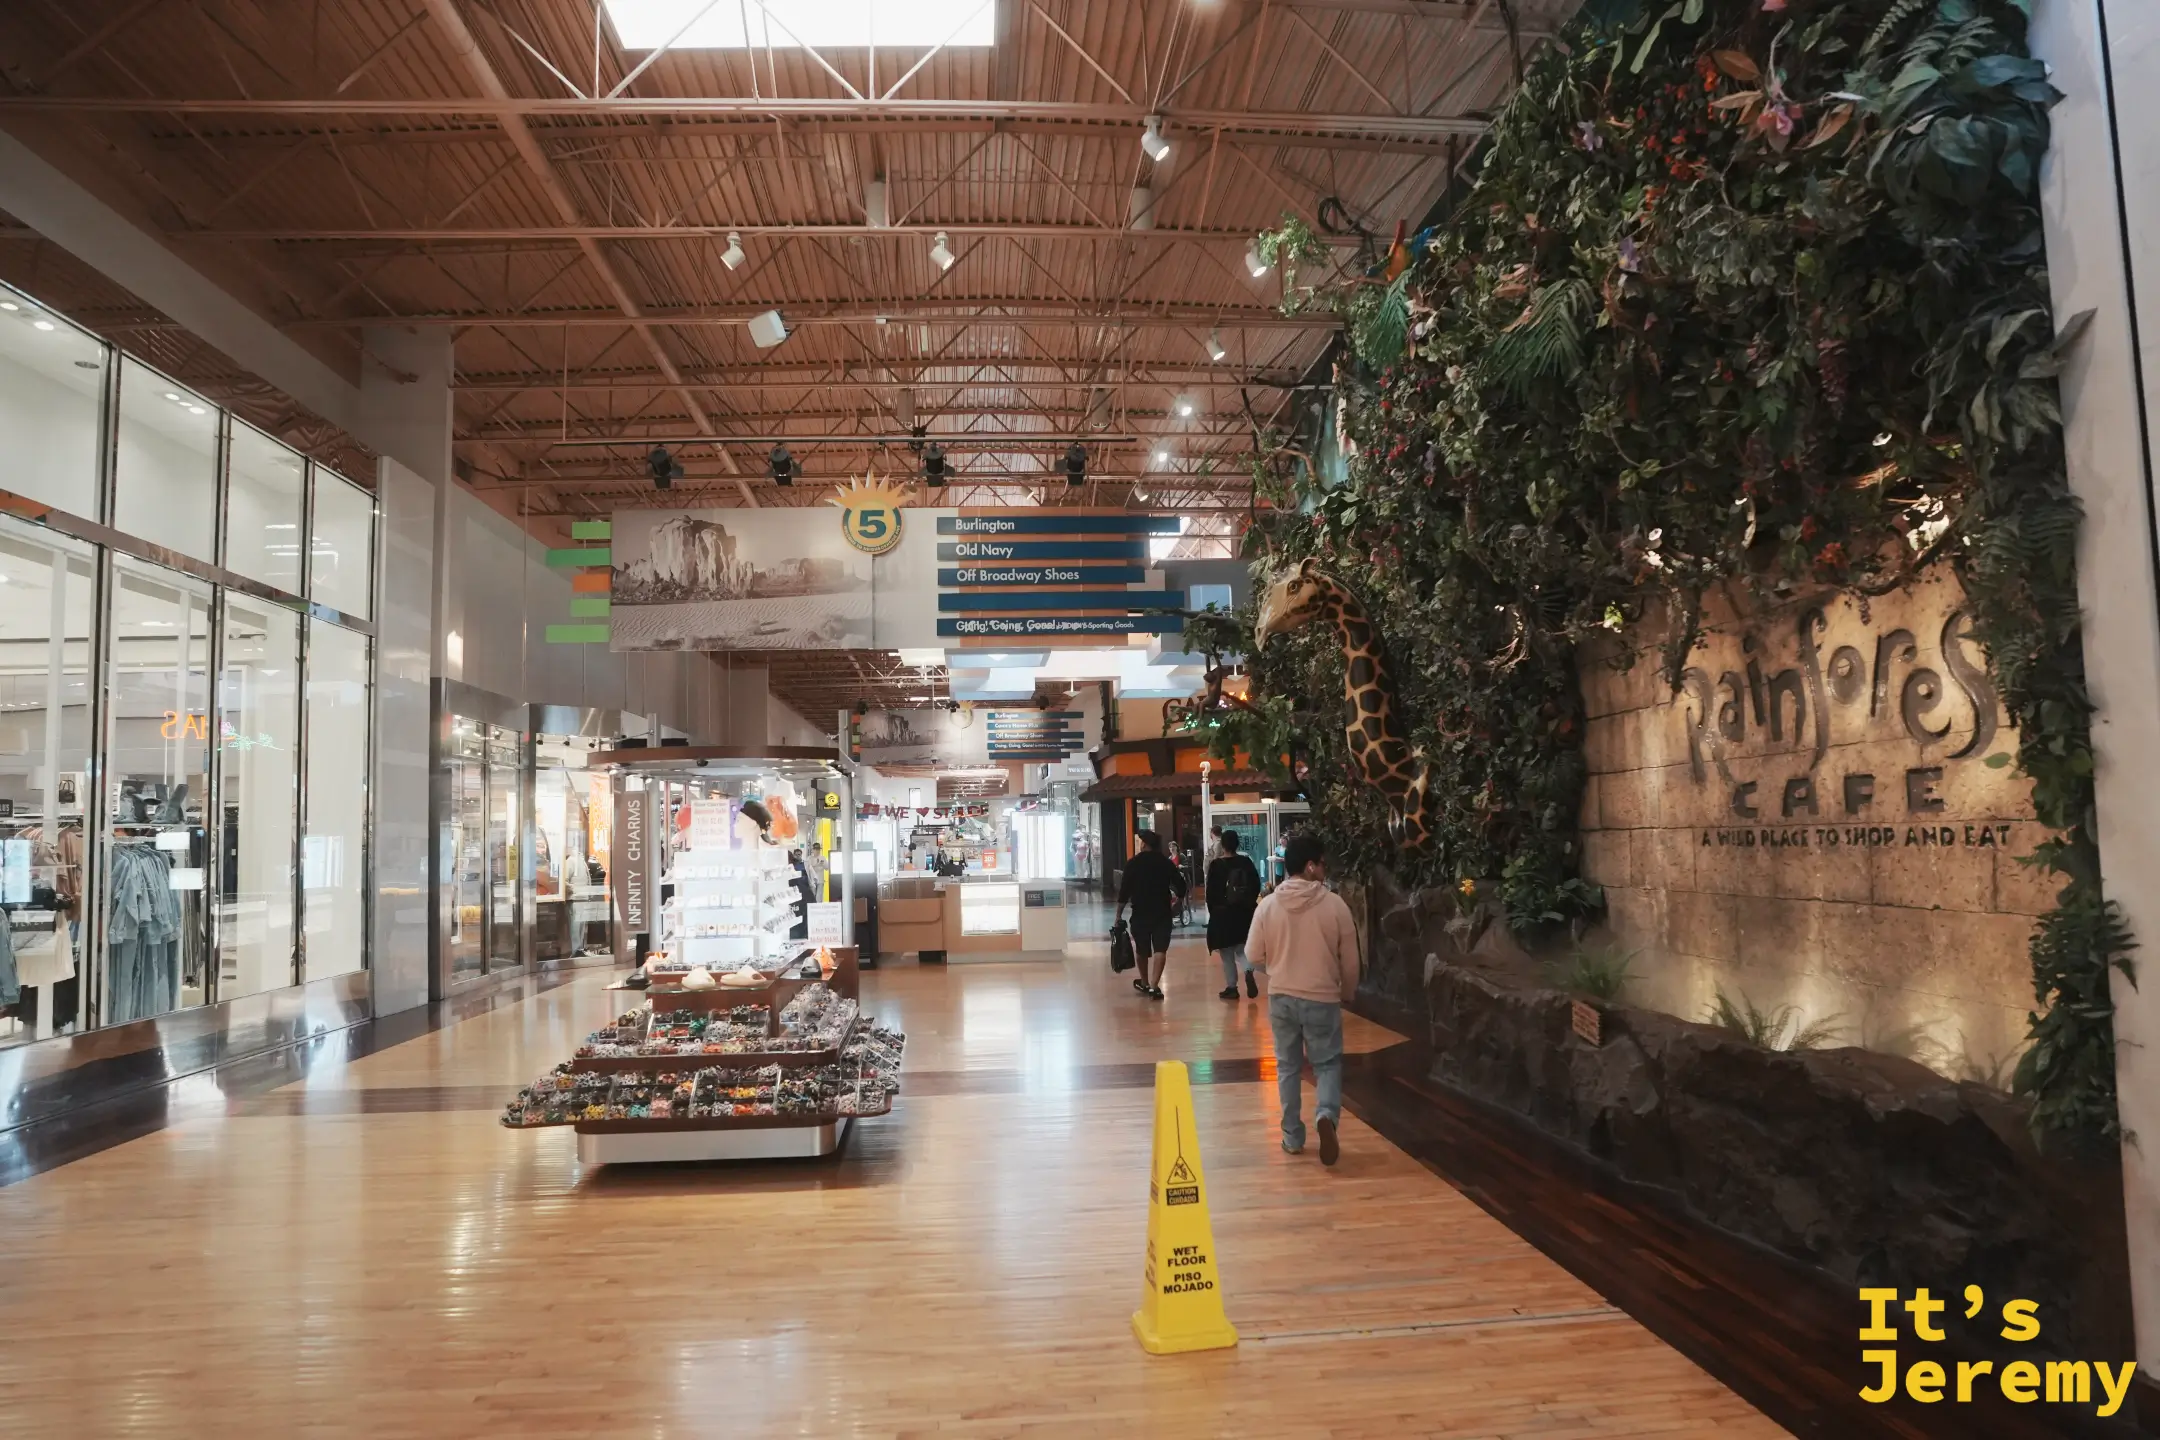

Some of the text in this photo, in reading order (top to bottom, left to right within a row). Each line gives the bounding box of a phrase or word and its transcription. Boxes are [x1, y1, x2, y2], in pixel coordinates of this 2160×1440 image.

[857, 509, 887, 539] 5
[955, 519, 1015, 533] Burlington
[955, 543, 1013, 559] Old Navy
[956, 568, 1080, 584] Off Broadway Shoes
[1114, 620, 1134, 629] Goods
[1683, 605, 1998, 786] Rainfores
[1732, 766, 1945, 819] CAFE
[885, 805, 909, 820] WE
[1702, 825, 2011, 848] A WILD PLACE TO SHOP AND EAT
[627, 799, 642, 925] INFINITY CHARMS
[1168, 1187, 1197, 1197] CAUTION
[1168, 1195, 1197, 1205] CUIDADO
[1173, 1245, 1198, 1257] WET
[1168, 1255, 1207, 1268] FLOOR
[1174, 1271, 1202, 1283] PISO
[1163, 1281, 1213, 1294] MOJADO
